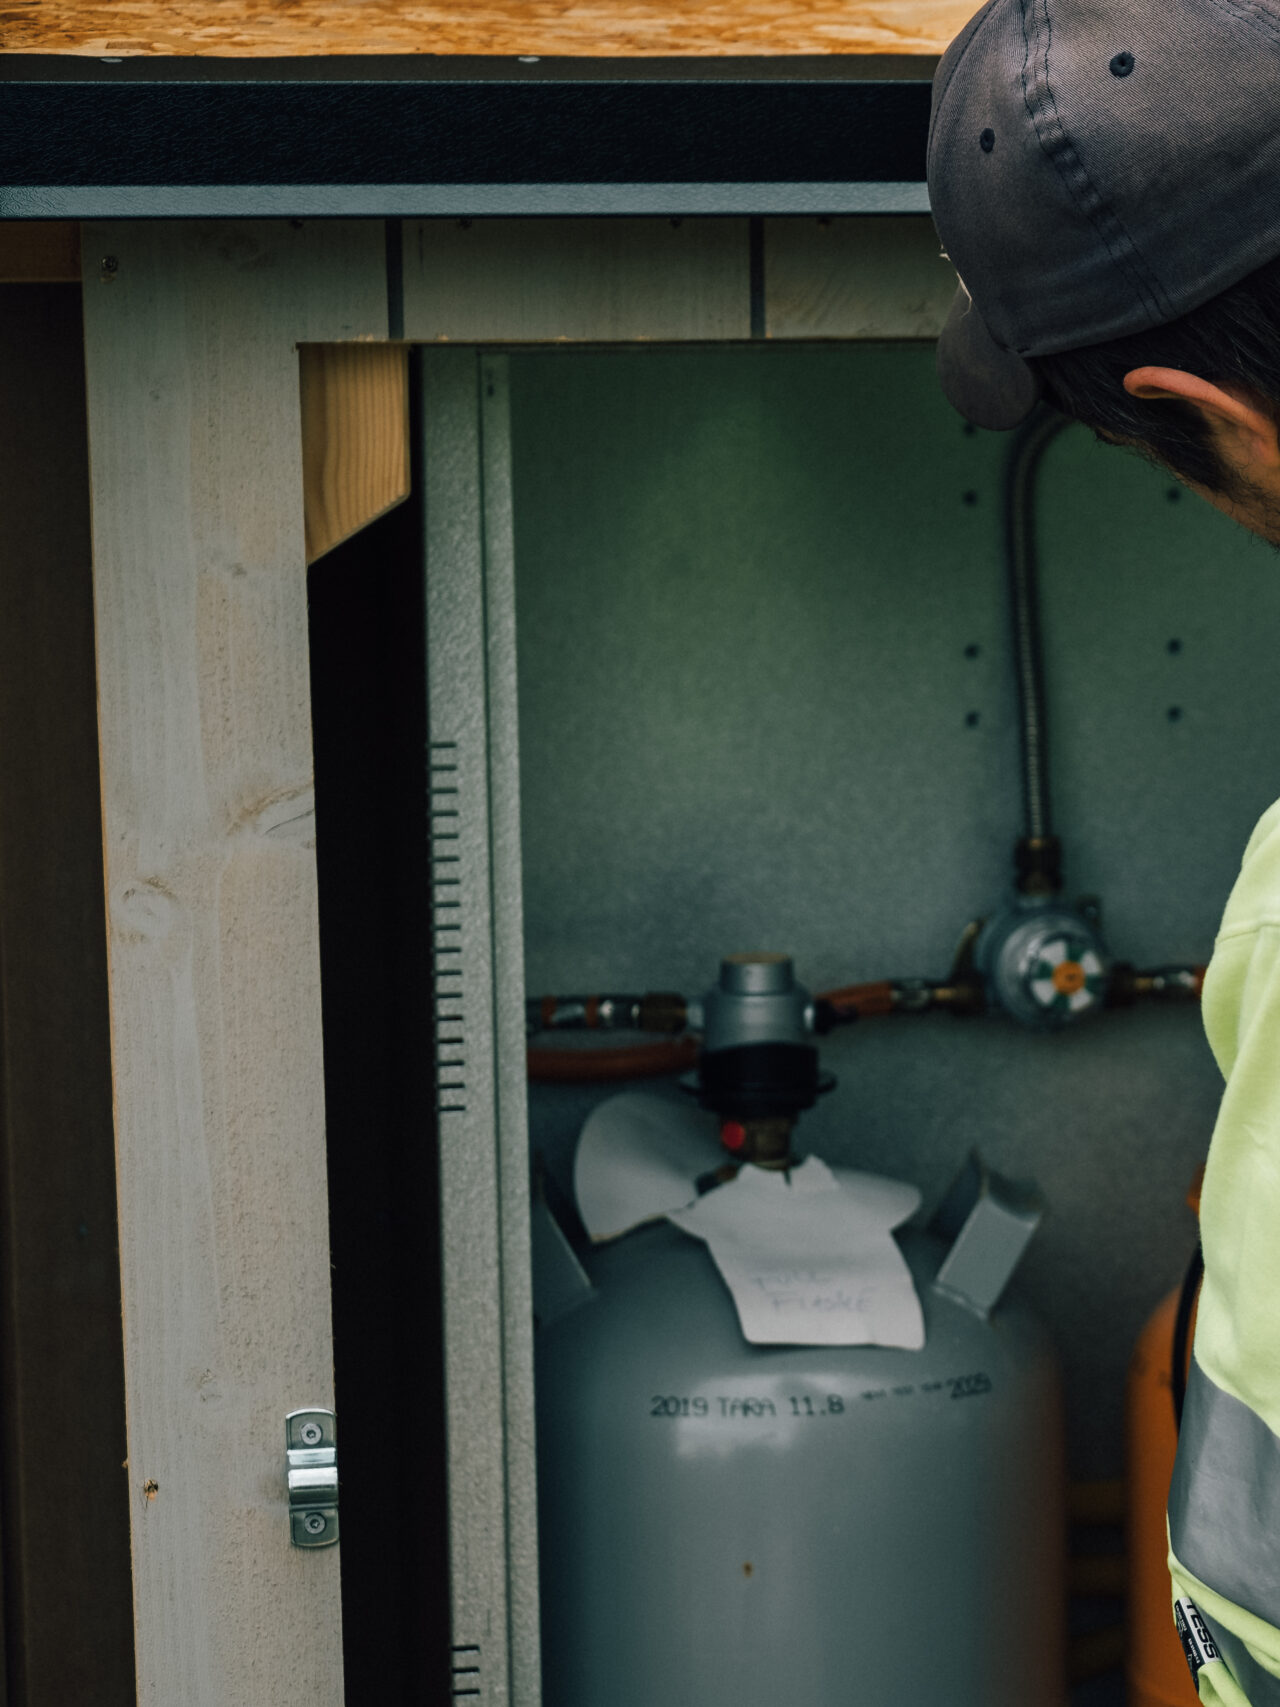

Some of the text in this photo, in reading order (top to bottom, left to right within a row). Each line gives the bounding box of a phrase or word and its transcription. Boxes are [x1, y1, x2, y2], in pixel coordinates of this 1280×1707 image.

[649, 1394, 709, 1417] 2019
[717, 1396, 778, 1418] TARA
[788, 1392, 846, 1416] 11.8
